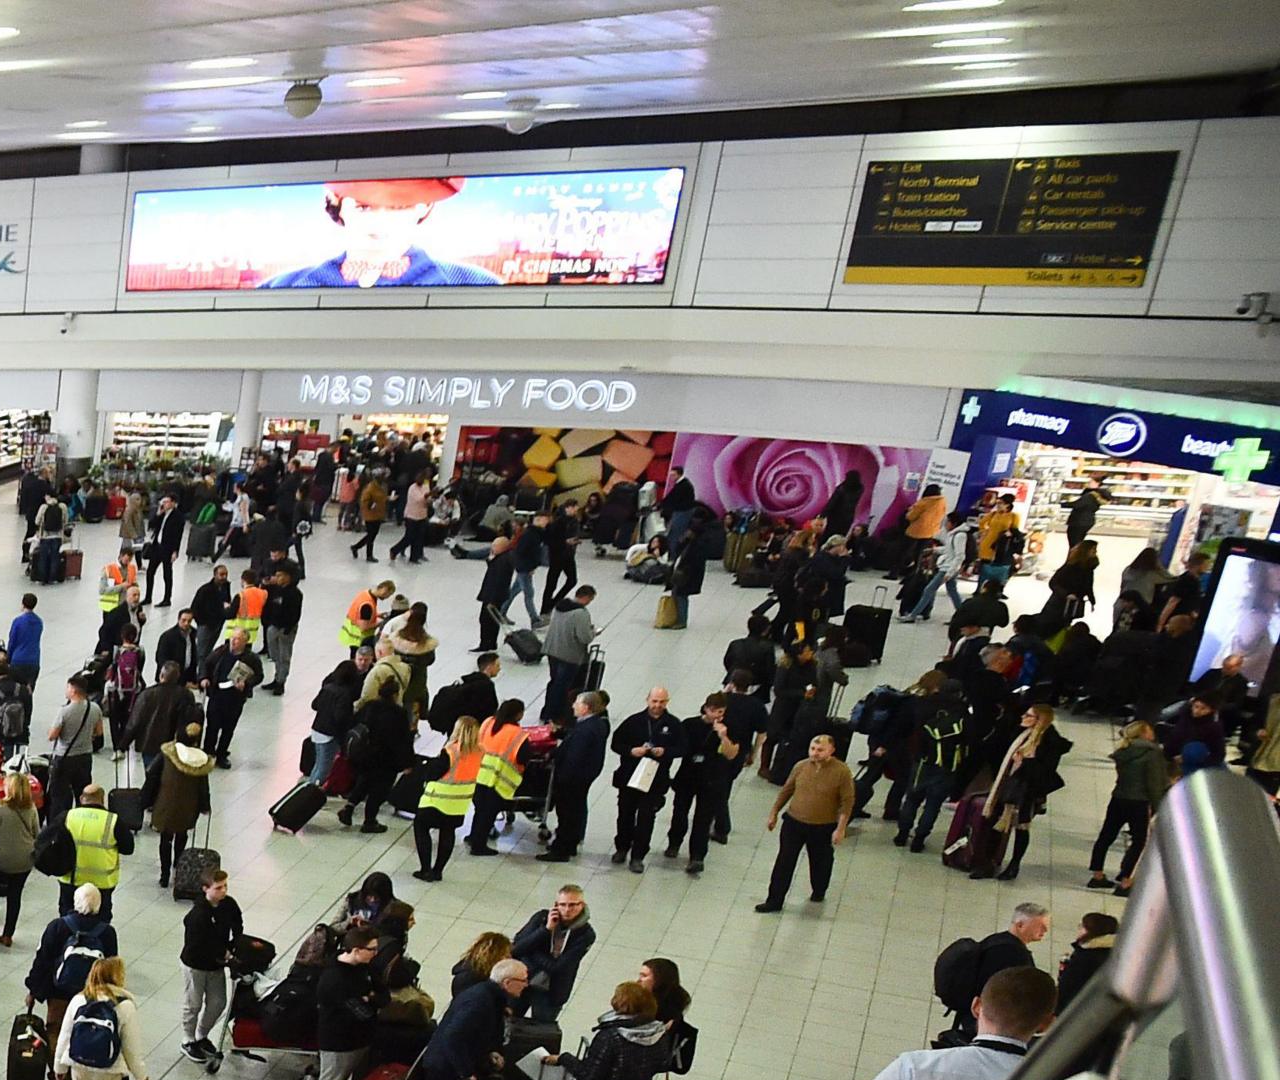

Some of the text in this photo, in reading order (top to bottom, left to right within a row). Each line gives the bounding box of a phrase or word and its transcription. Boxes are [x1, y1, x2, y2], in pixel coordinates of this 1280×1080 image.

[902, 162, 922, 173] Exit
[899, 175, 980, 188] North Terminal
[924, 191, 961, 203] station
[522, 257, 591, 274] CINEMAS
[594, 256, 631, 273] NOW
[299, 374, 638, 412] M&S SIMPLY FOOD
[1006, 408, 1071, 436] pharmacy
